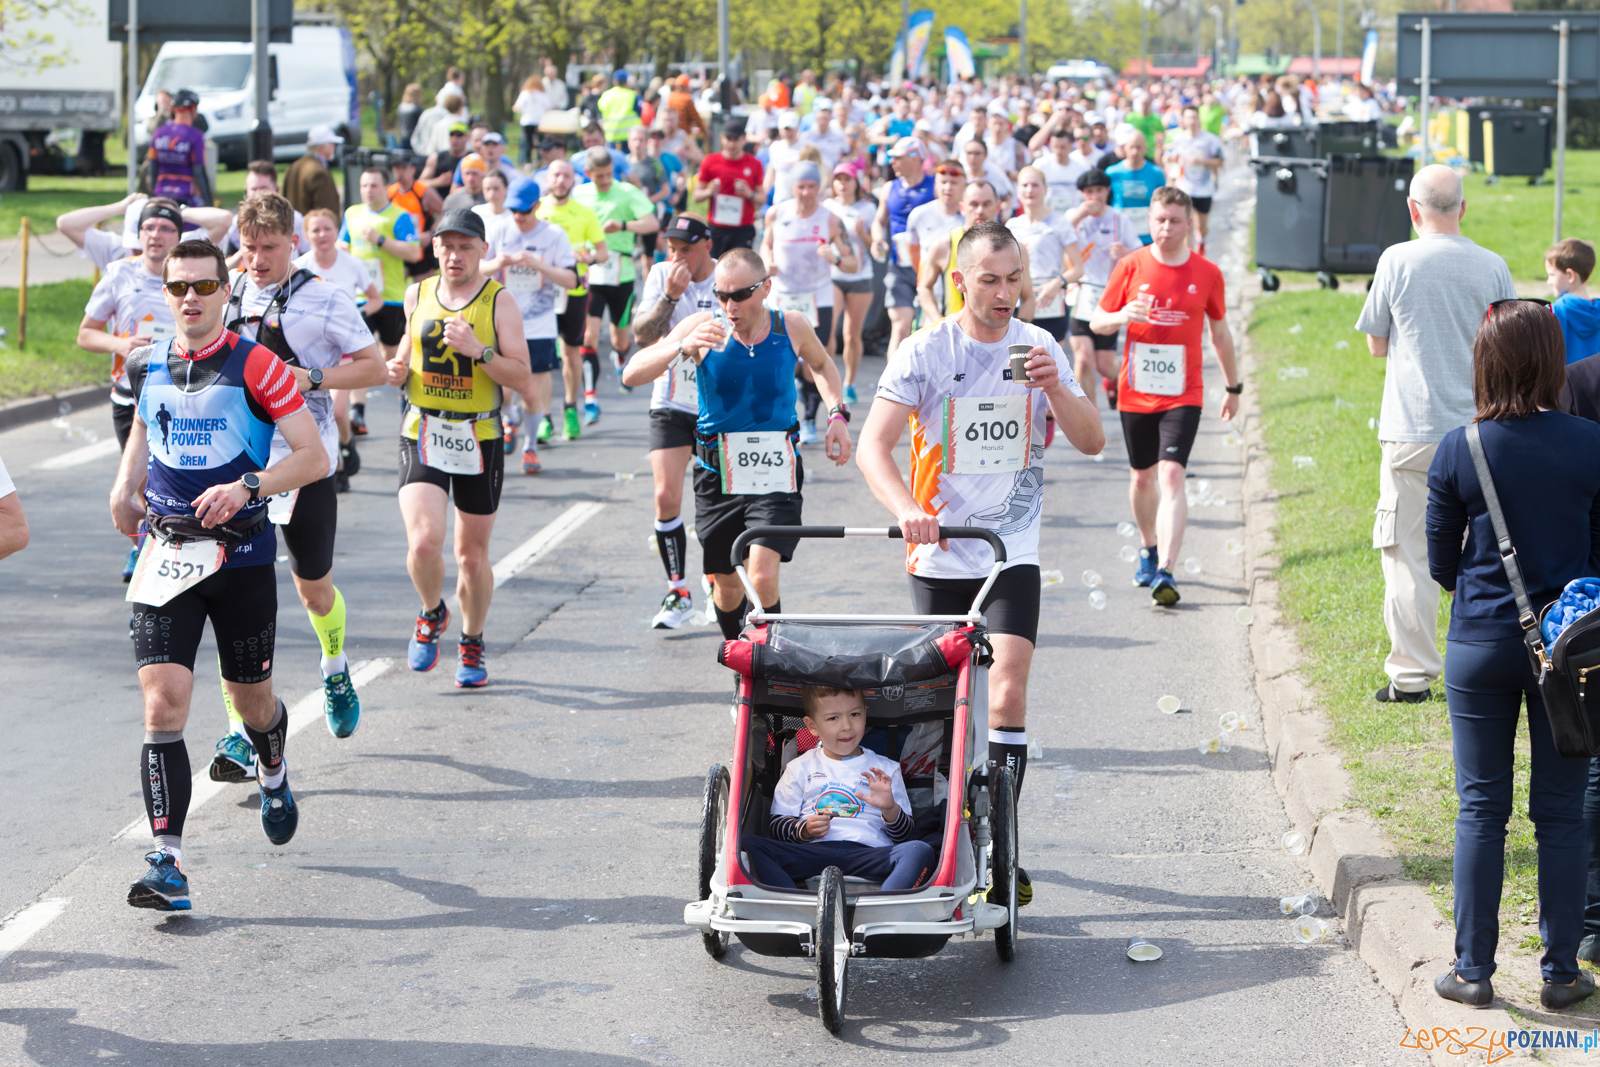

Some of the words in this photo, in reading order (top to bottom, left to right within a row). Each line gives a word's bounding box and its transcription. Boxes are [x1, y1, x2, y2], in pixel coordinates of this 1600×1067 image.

[1142, 359, 1176, 374] 2106
[432, 373, 464, 389] night
[953, 373, 966, 382] 4F
[423, 386, 473, 399] runners
[171, 417, 228, 432] RUNNER'S
[965, 419, 1019, 441] 6100
[171, 432, 212, 446] POWER
[431, 432, 475, 452] 11650
[179, 454, 207, 467] ŚREM
[738, 450, 784, 467] 8943
[157, 558, 205, 581] 5521
